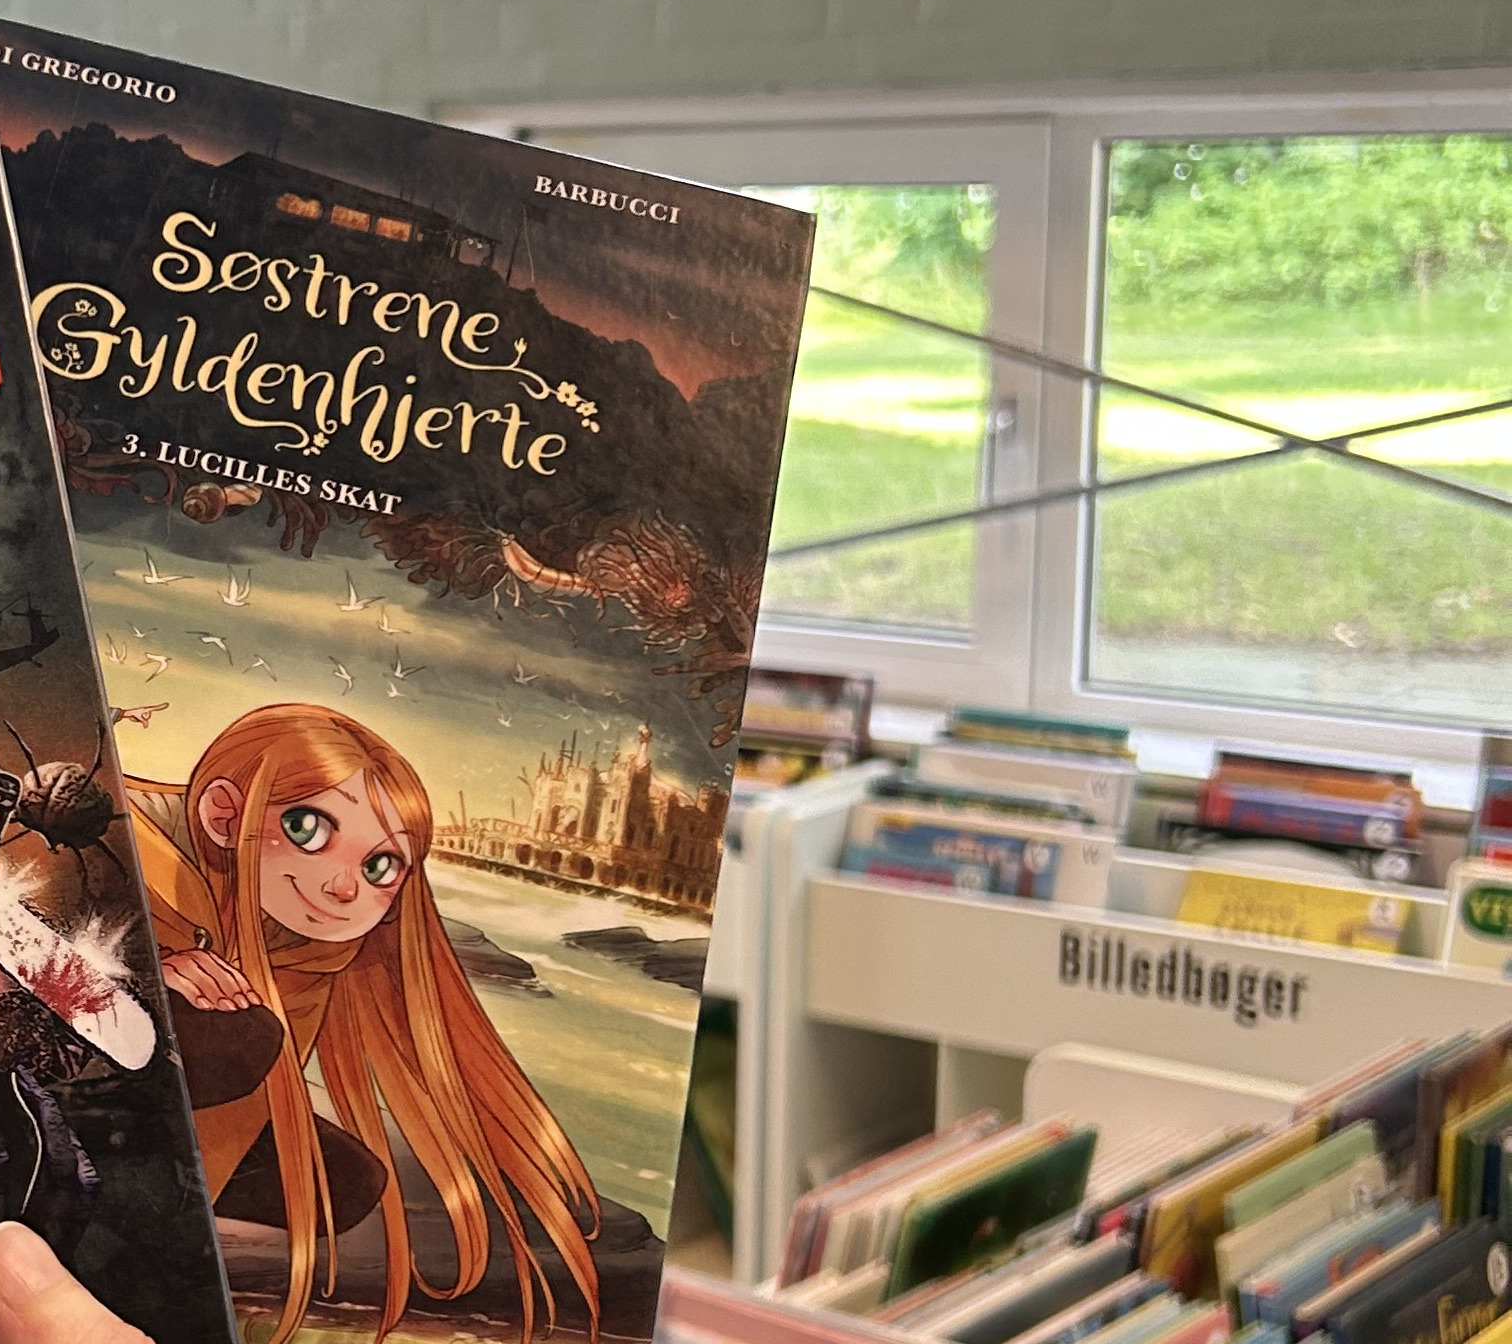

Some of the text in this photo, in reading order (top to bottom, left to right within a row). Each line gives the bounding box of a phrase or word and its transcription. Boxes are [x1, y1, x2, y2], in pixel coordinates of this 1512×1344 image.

[21, 52, 177, 104] GREGORIO
[534, 175, 681, 224] BARBUCCI
[151, 210, 502, 368] Søstrene
[30, 282, 568, 476] Gyldenhjerte
[121, 434, 401, 516] 3. LUCILLES SKAT
[1059, 926, 1309, 1029] Billedbøger
